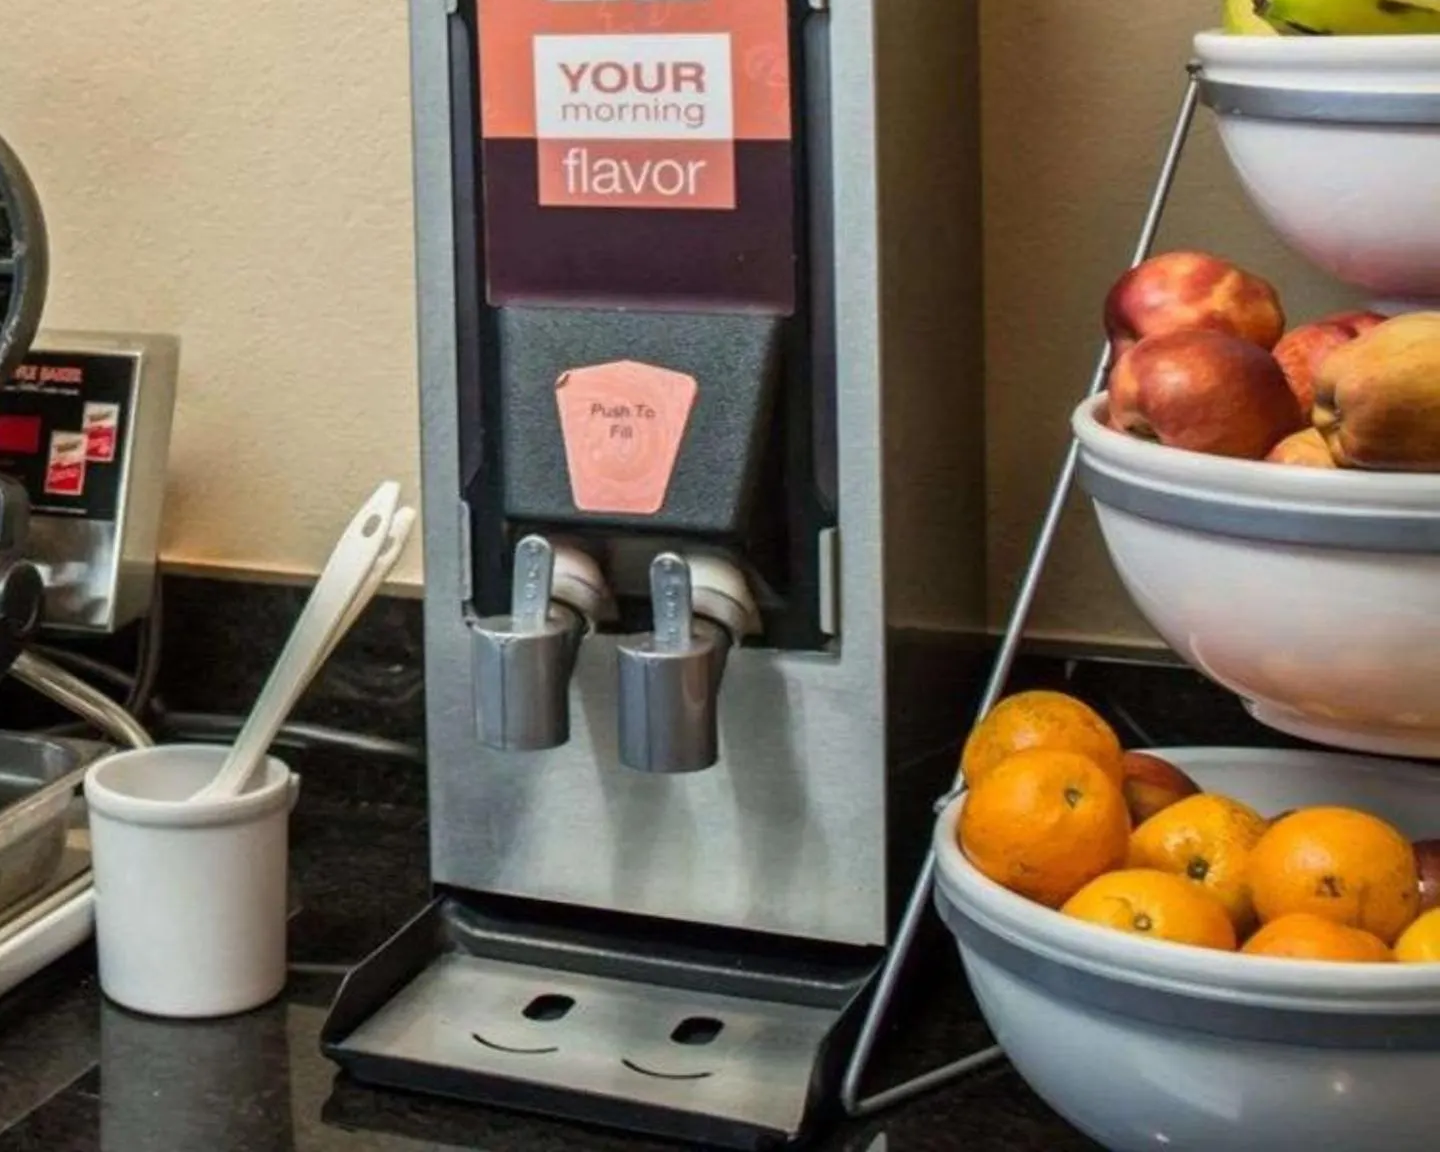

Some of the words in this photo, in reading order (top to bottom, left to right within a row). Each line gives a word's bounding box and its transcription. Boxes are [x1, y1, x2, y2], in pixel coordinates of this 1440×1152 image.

[557, 61, 706, 95] YOUR
[560, 99, 706, 129] morning
[561, 147, 708, 195] flavor
[591, 403, 630, 417] Push
[634, 404, 657, 419] To
[610, 426, 633, 440] Fill
